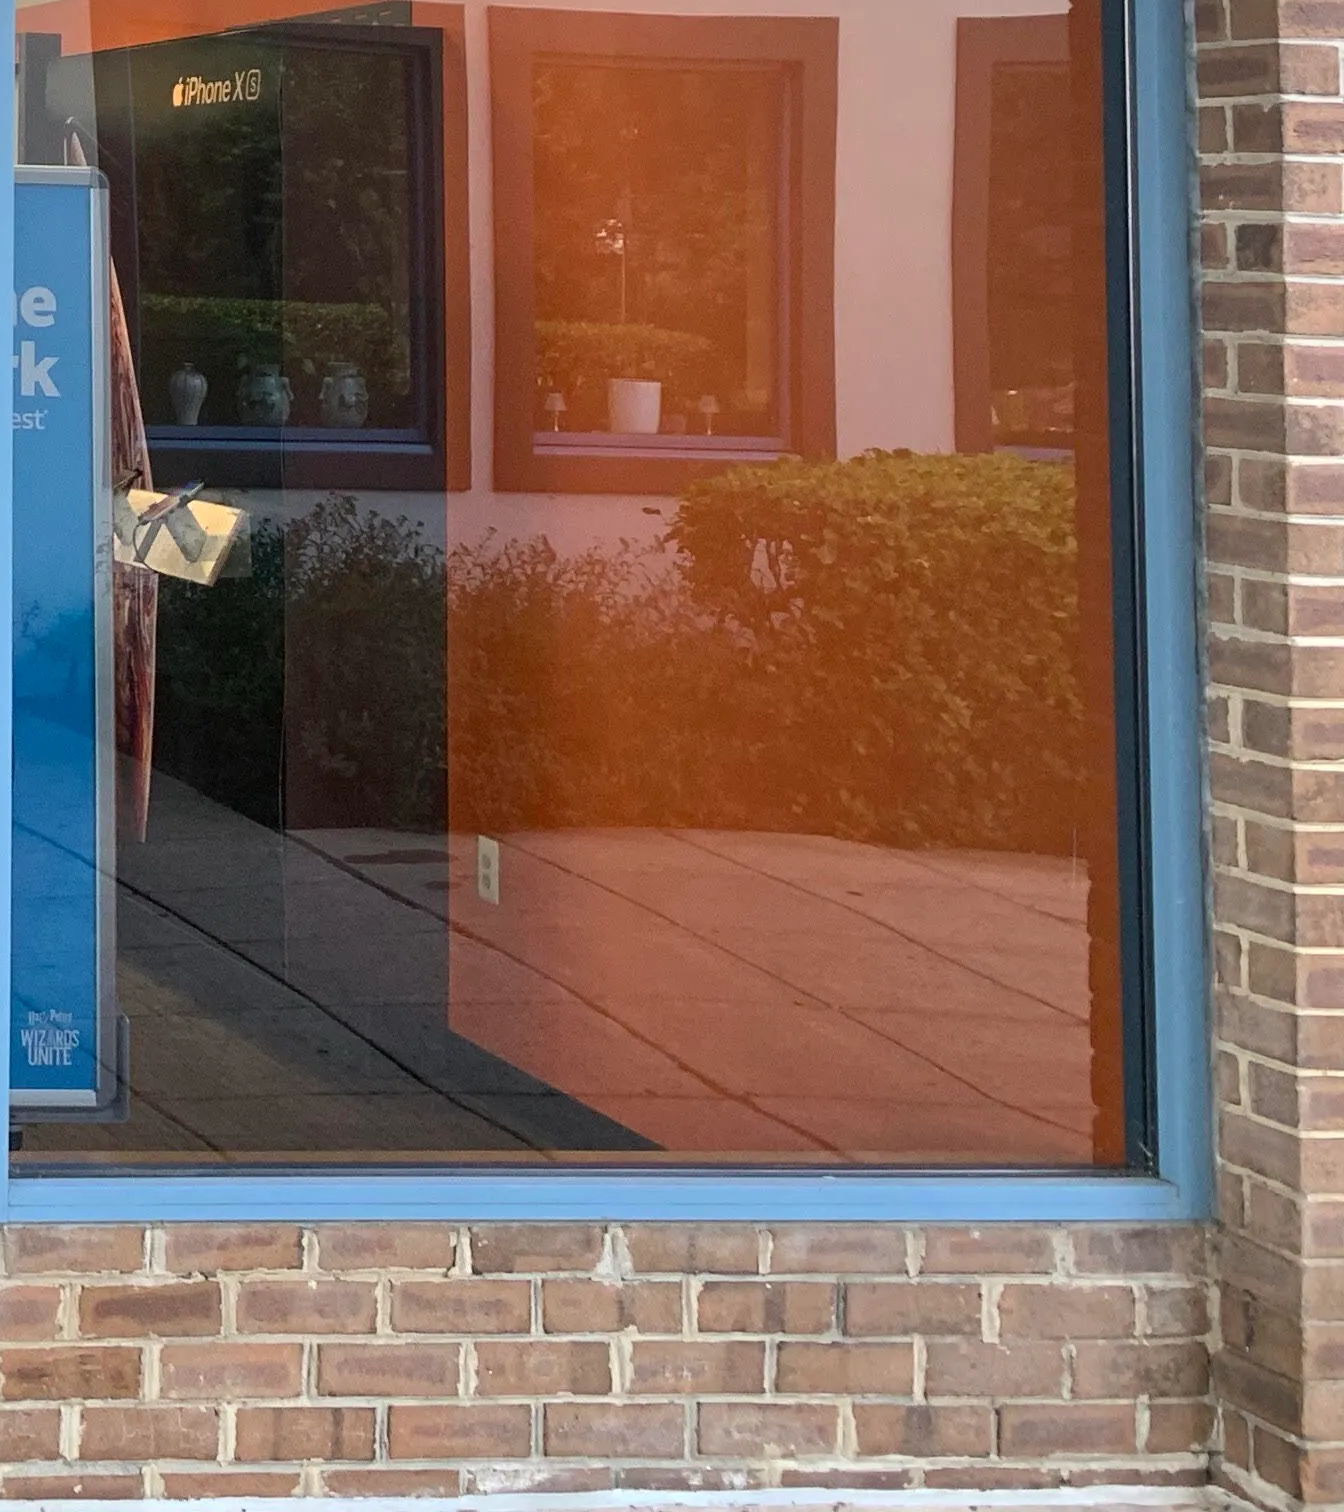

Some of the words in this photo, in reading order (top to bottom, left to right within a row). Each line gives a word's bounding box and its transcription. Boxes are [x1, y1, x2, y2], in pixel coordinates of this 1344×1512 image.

[185, 75, 231, 106] iPhone
[21, 1029, 79, 1047] WIZARDS
[28, 1046, 72, 1066] UNITE
